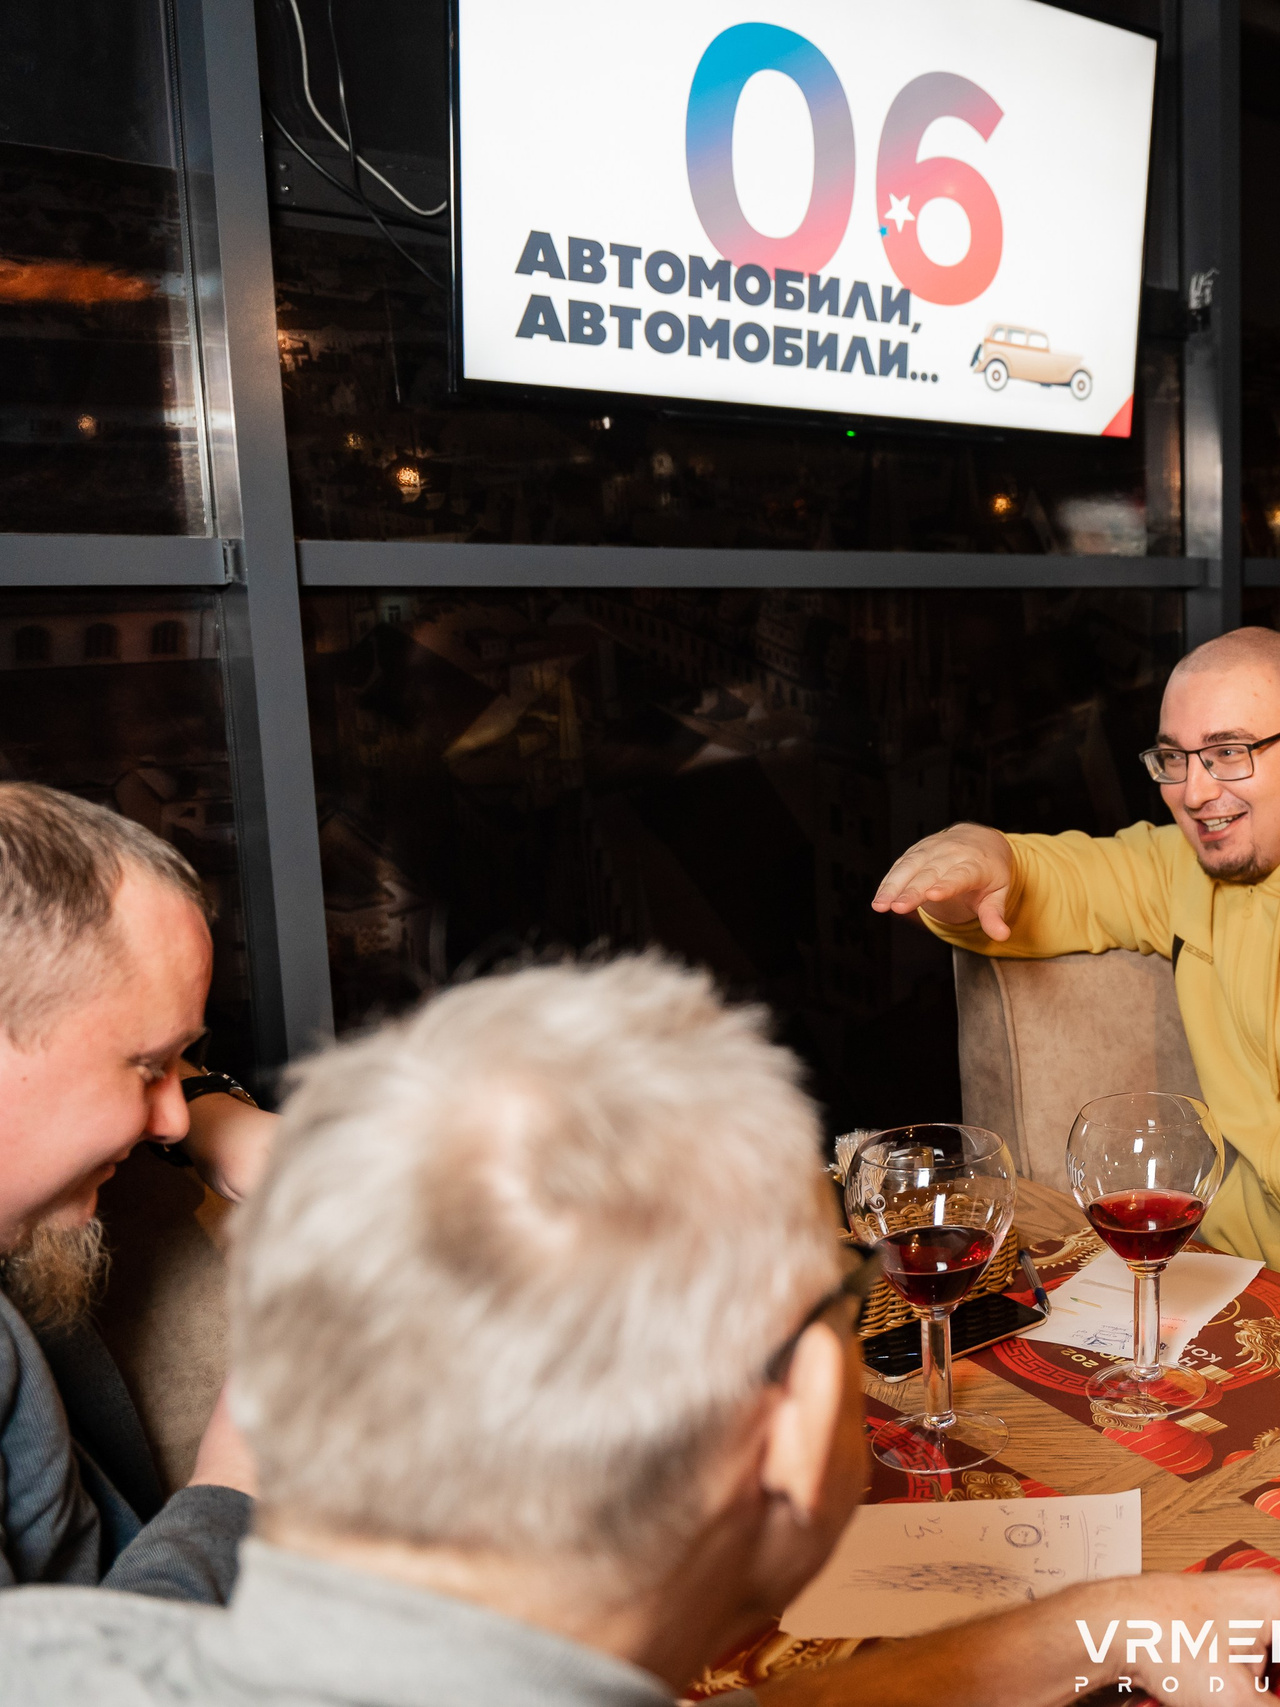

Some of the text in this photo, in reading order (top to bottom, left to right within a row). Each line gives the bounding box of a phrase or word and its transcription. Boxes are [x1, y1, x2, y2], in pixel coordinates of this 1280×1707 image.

[686, 22, 1004, 306] 06
[515, 230, 922, 332] АВТОМОБИЛИ,
[515, 294, 939, 383] АВТОМОБИЛИ...
